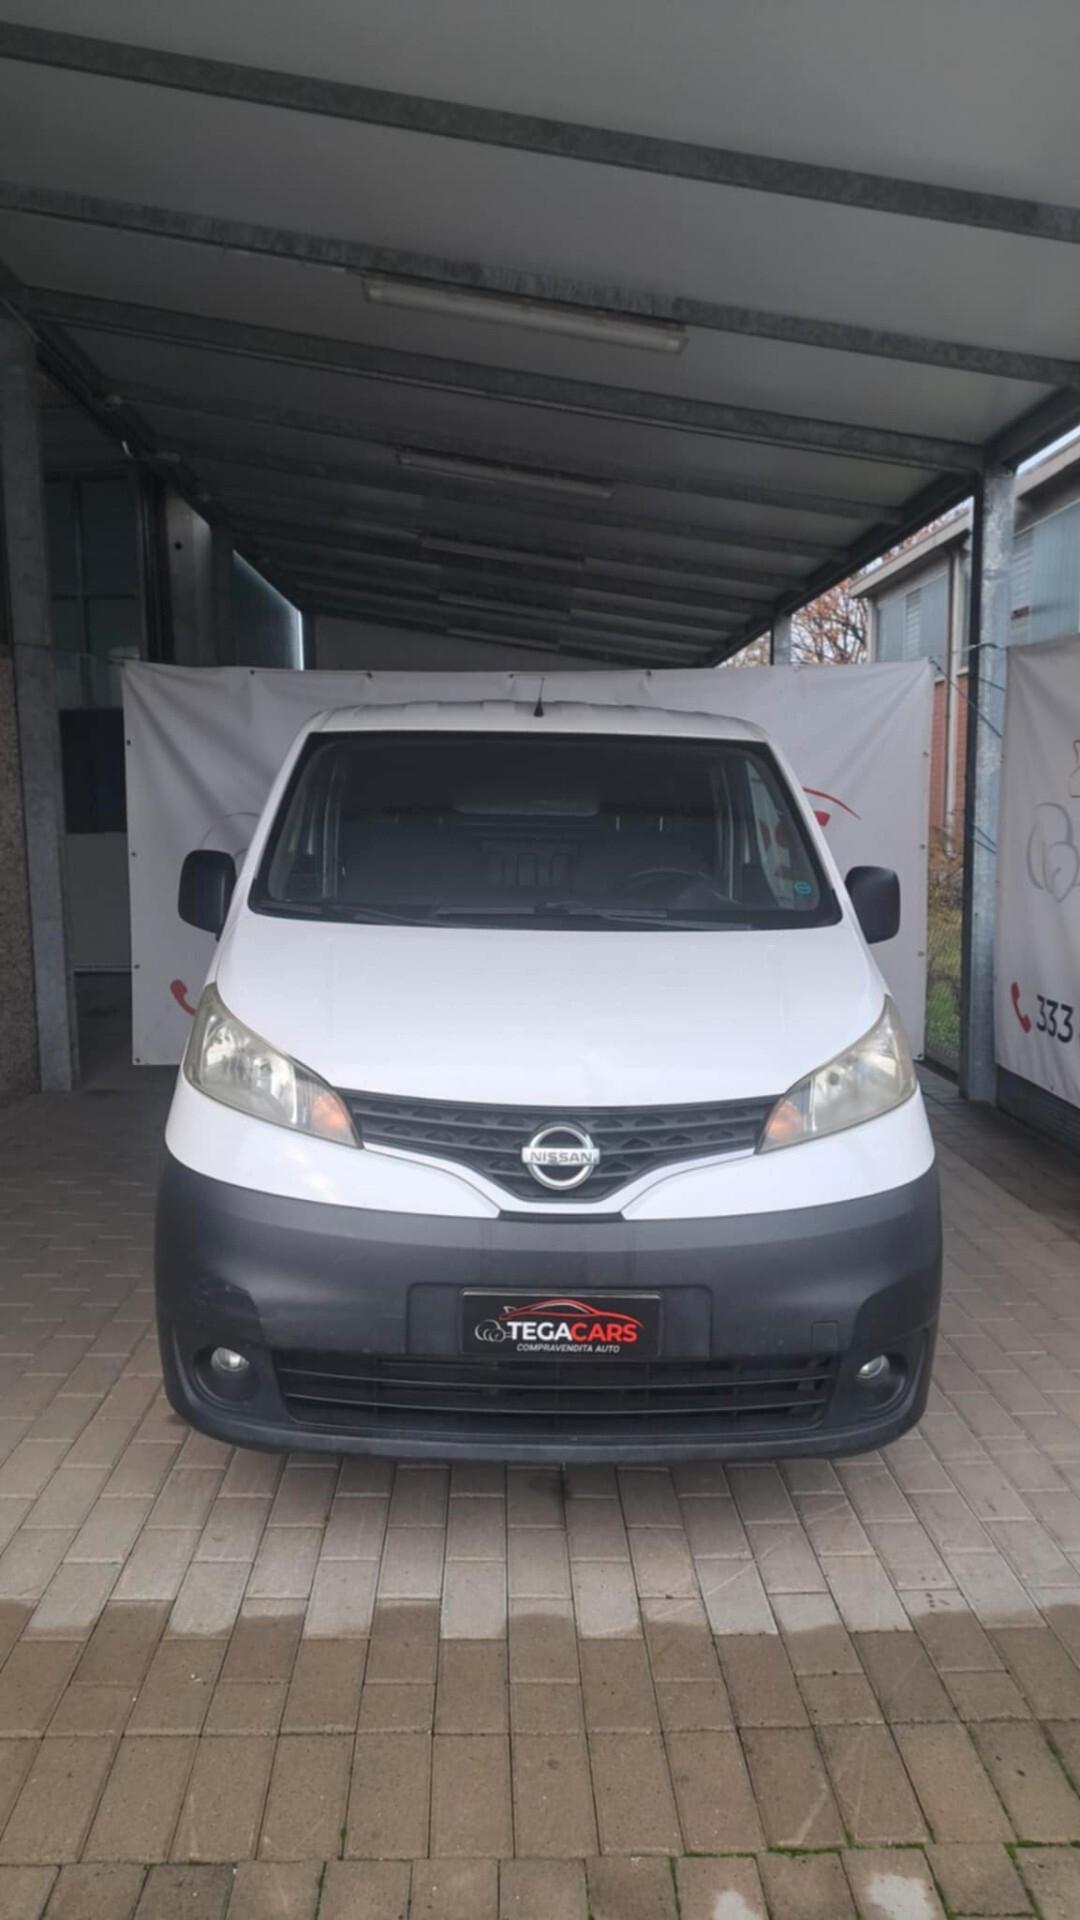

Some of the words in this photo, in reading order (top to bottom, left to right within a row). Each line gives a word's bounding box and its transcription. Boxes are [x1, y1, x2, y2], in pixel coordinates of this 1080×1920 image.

[1036, 993, 1074, 1043] 333
[530, 1151, 593, 1162] NISSAN
[506, 1321, 638, 1343] TEGACARS
[516, 1343, 593, 1353] COMPRAVENDITA
[595, 1344, 620, 1353] AUTO
